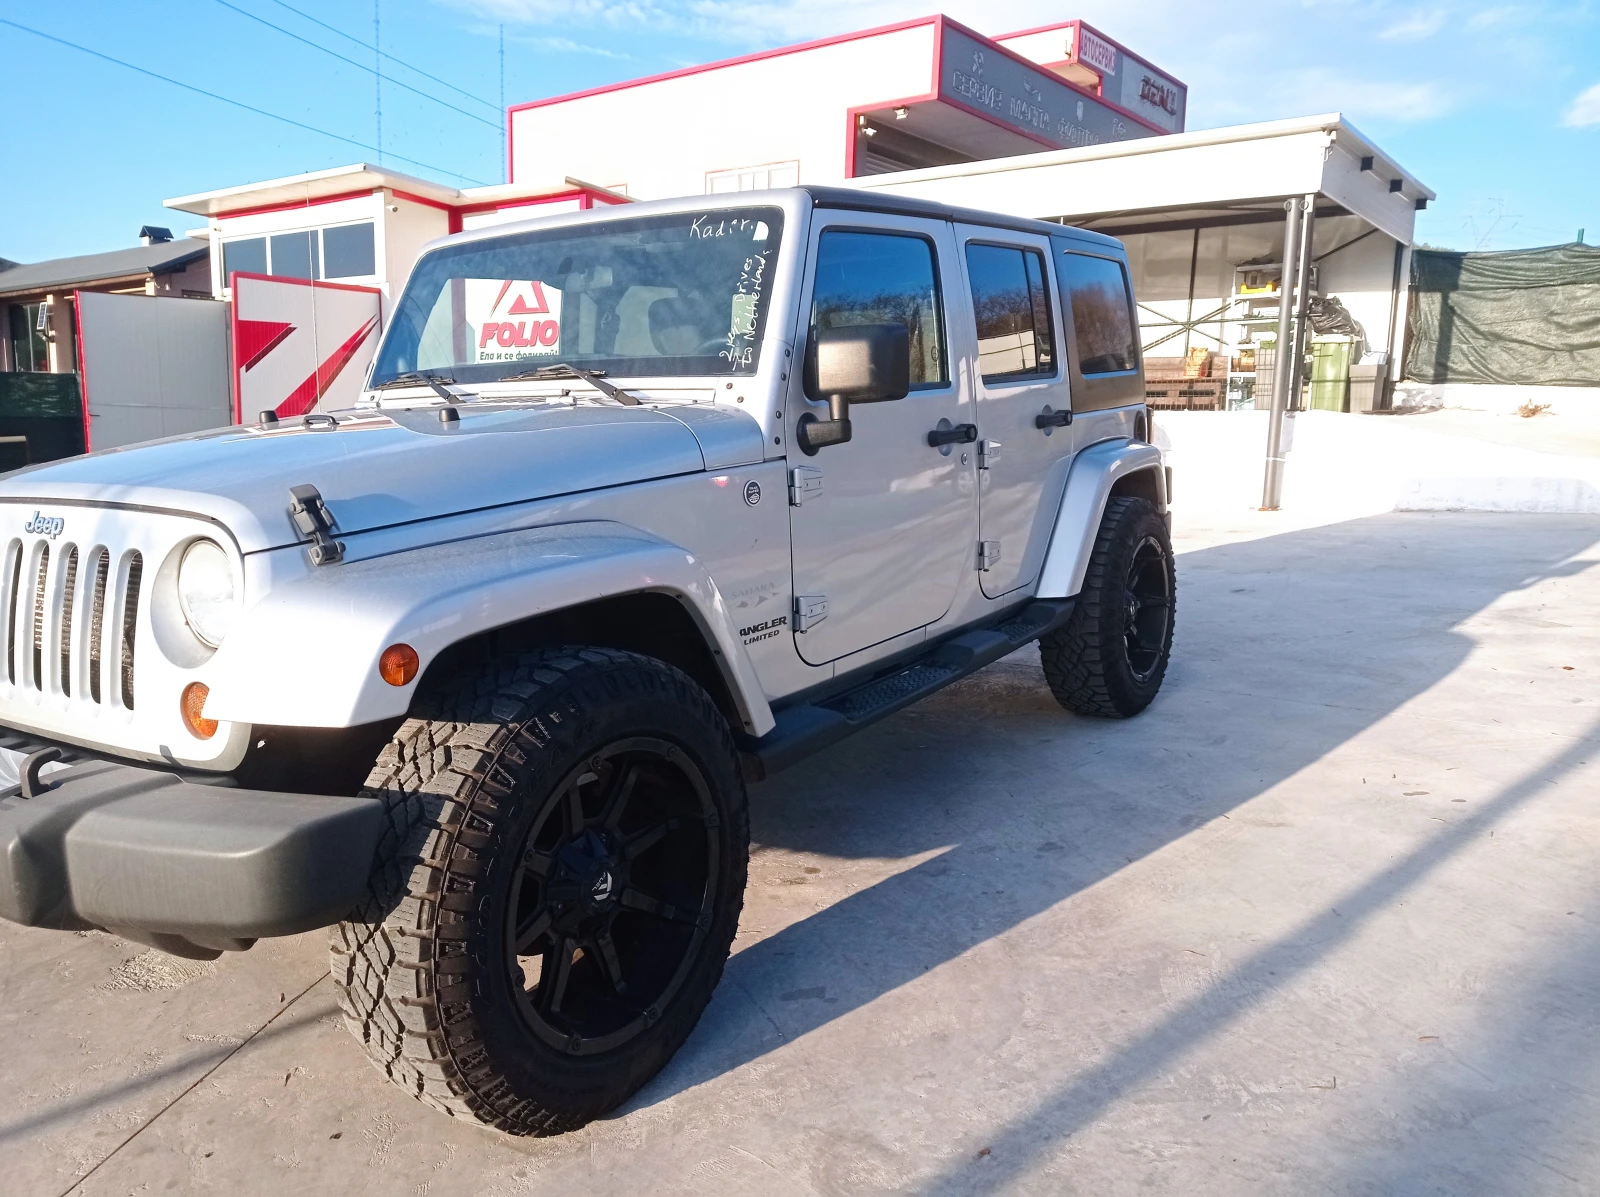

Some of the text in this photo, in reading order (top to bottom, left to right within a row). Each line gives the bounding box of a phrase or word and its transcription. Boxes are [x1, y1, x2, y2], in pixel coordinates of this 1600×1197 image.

[479, 320, 560, 348] FOLIO
[25, 511, 64, 540] Jeep
[744, 630, 780, 645] LIMITED
